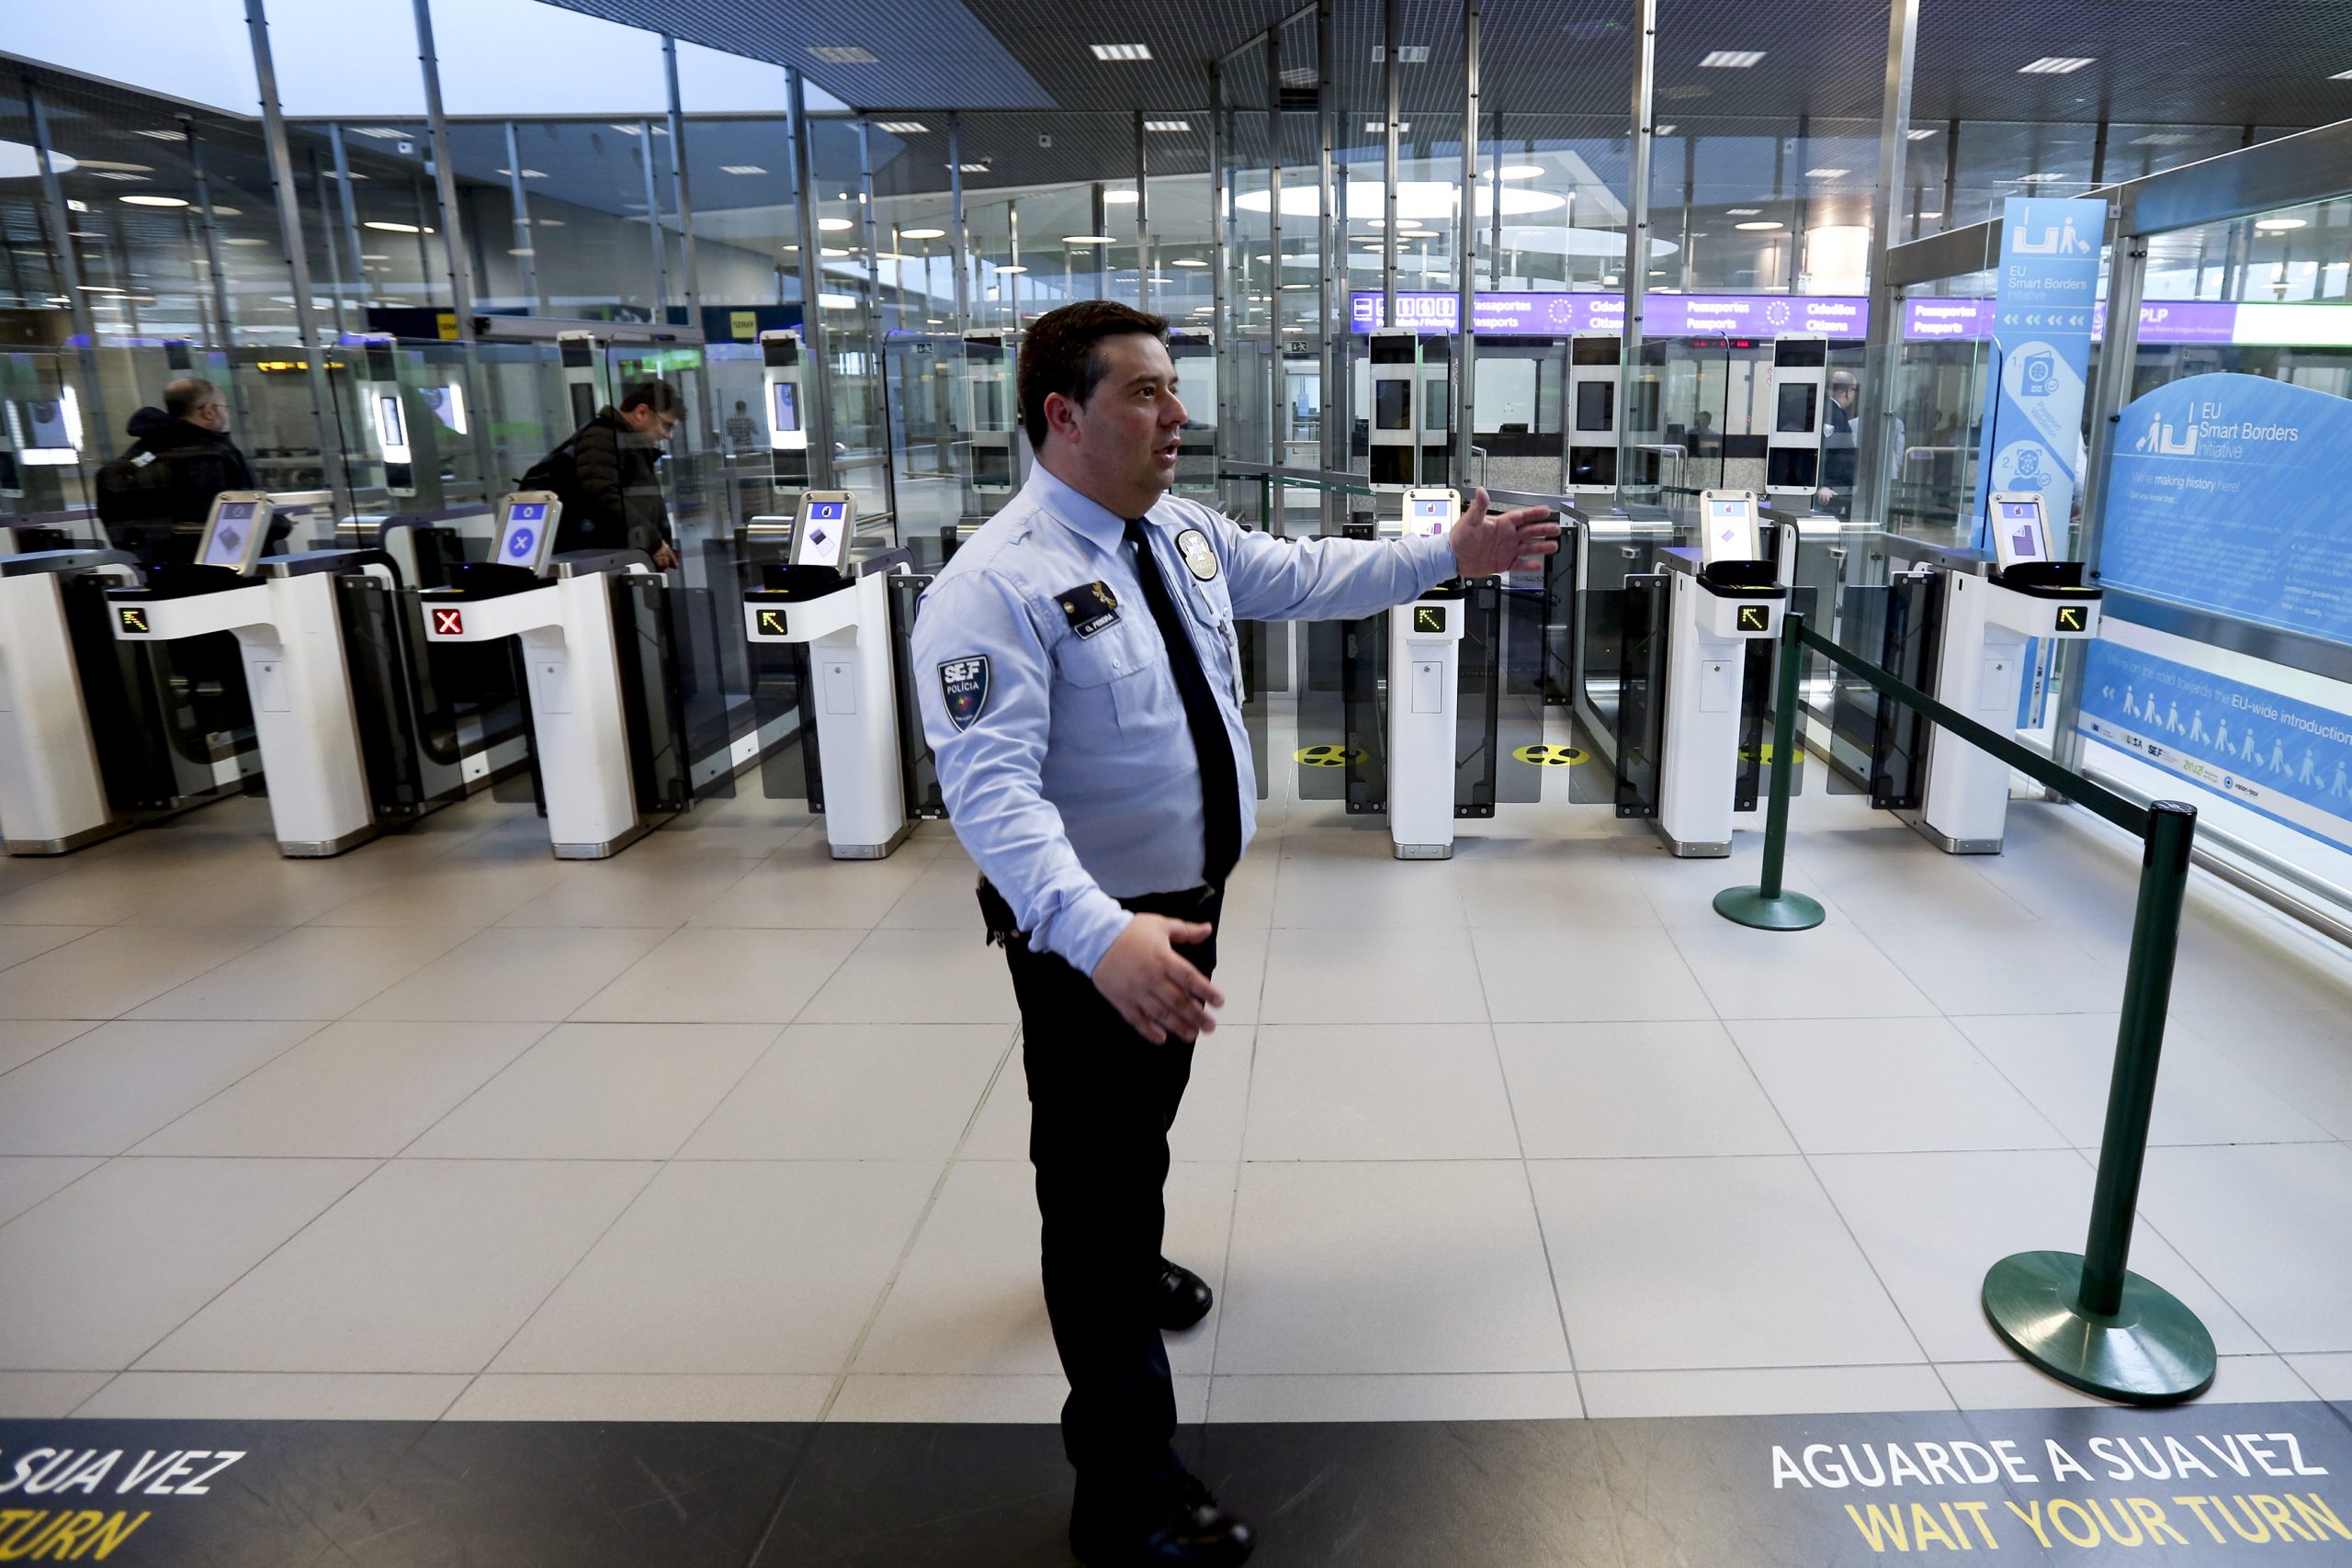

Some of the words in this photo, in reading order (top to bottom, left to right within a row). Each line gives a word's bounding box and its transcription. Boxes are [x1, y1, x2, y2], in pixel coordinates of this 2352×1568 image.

[2009, 265, 2027, 276] EU
[2008, 277, 2041, 288] Smart
[2044, 278, 2087, 289] Borders
[2007, 289, 2047, 301] Initiative
[1474, 300, 1532, 312] assaportes
[1687, 301, 1749, 314] Passaportes
[1915, 305, 1976, 319] Passaportes
[1474, 317, 1519, 329] assports
[1687, 318, 1736, 331] Passports
[1805, 321, 1849, 333] Citizens
[1914, 321, 1963, 335] Passports
[2202, 402, 2222, 419] EU
[2199, 422, 2238, 439] Smart
[2242, 423, 2299, 442] Borders
[2197, 442, 2243, 459] Initiative
[2002, 457, 2013, 468] 2.
[2154, 475, 2185, 490] making
[2187, 476, 2216, 493] history
[945, 661, 979, 682] SEF
[946, 682, 979, 695] POLÍCIA
[2130, 662, 2141, 674] on
[2156, 669, 2177, 686] road
[2177, 675, 2212, 699] towards
[2214, 688, 2231, 705] the
[2232, 694, 2278, 721] EU-wide
[2281, 708, 2352, 746] introduction
[2148, 744, 2163, 758] SEF
[1771, 1439, 2041, 1489] AGUARDE
[2044, 1438, 2096, 1483] A
[2081, 1435, 2205, 1482] SUA
[2196, 1432, 2329, 1478] VEZ
[0, 1448, 123, 1495] SUA
[116, 1450, 247, 1495] VEZ
[1844, 1501, 2000, 1552] WAIT
[2004, 1497, 2191, 1550] YOUR
[2175, 1492, 2352, 1545] TURN
